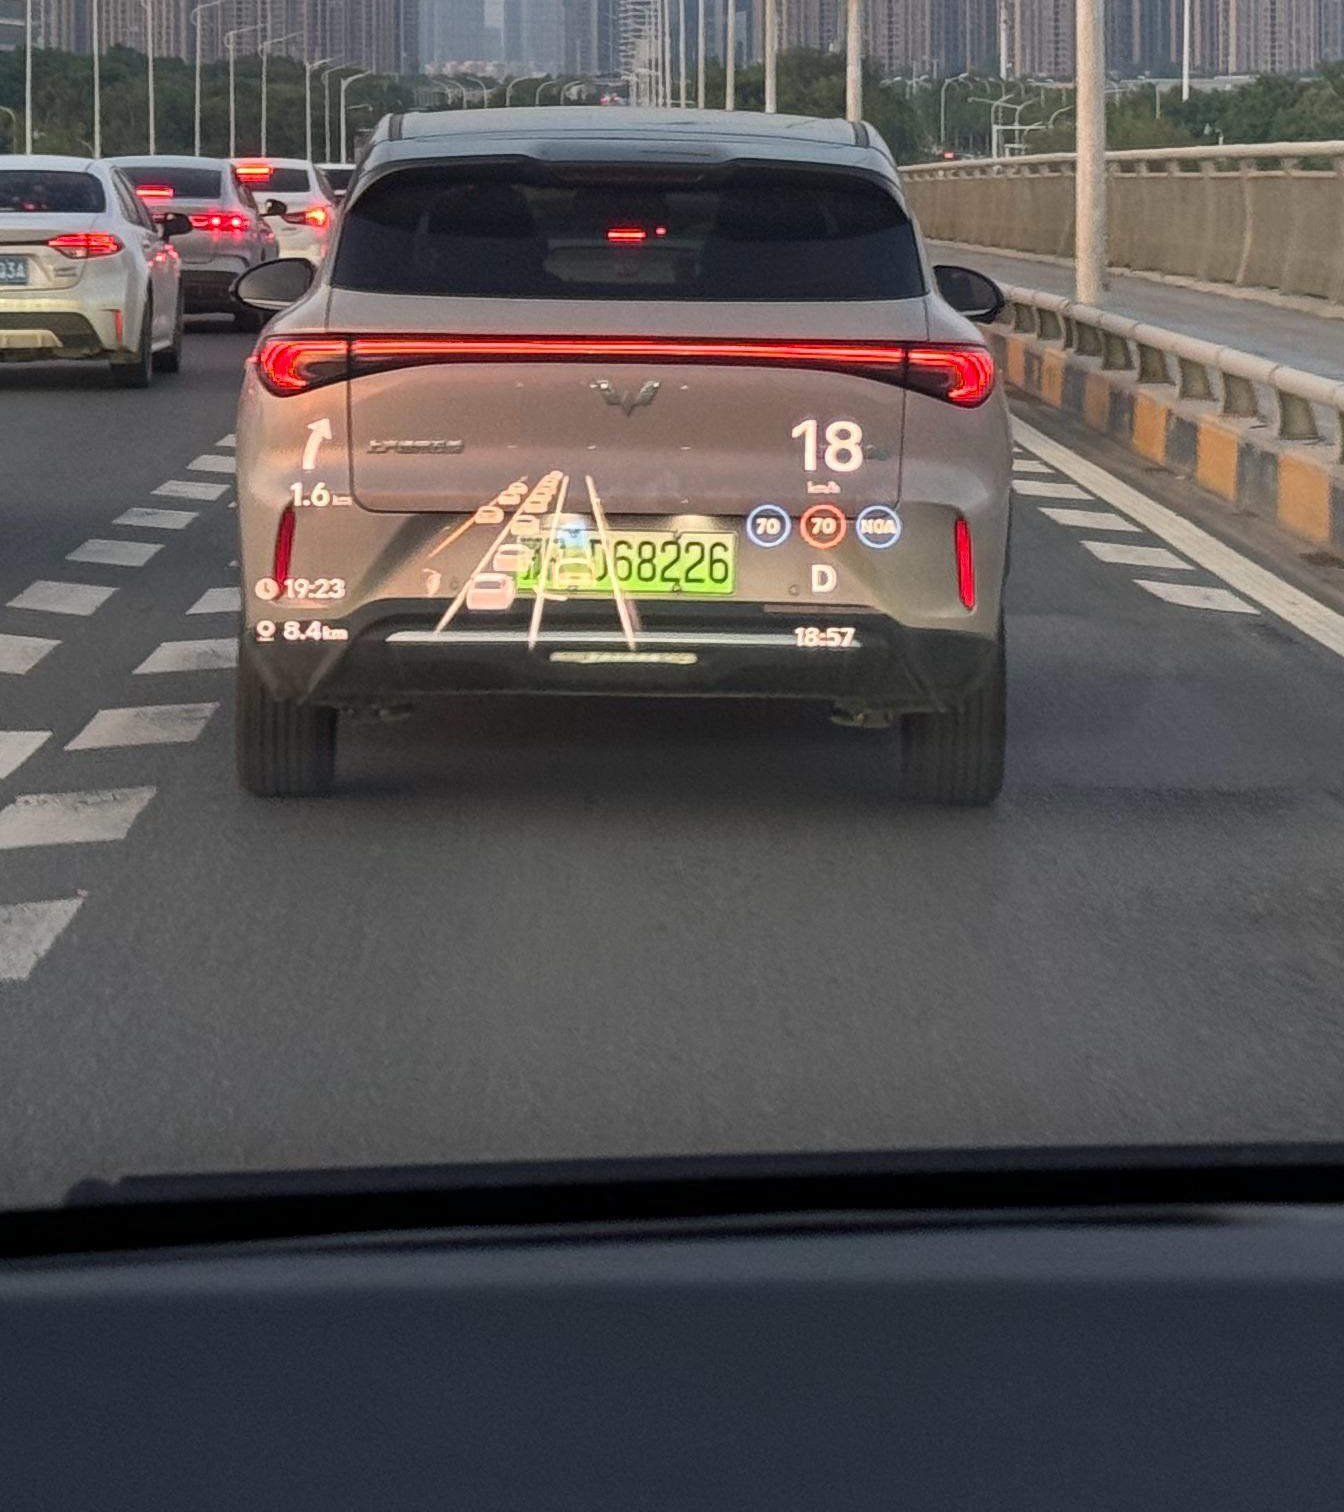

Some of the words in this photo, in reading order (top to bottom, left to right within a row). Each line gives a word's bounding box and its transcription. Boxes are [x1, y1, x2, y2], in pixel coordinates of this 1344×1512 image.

[791, 419, 863, 472] 18
[756, 517, 781, 535] 70
[811, 517, 837, 535] 70
[285, 578, 346, 599] 19:23
[811, 564, 837, 593] D
[794, 627, 856, 647] 18:57
